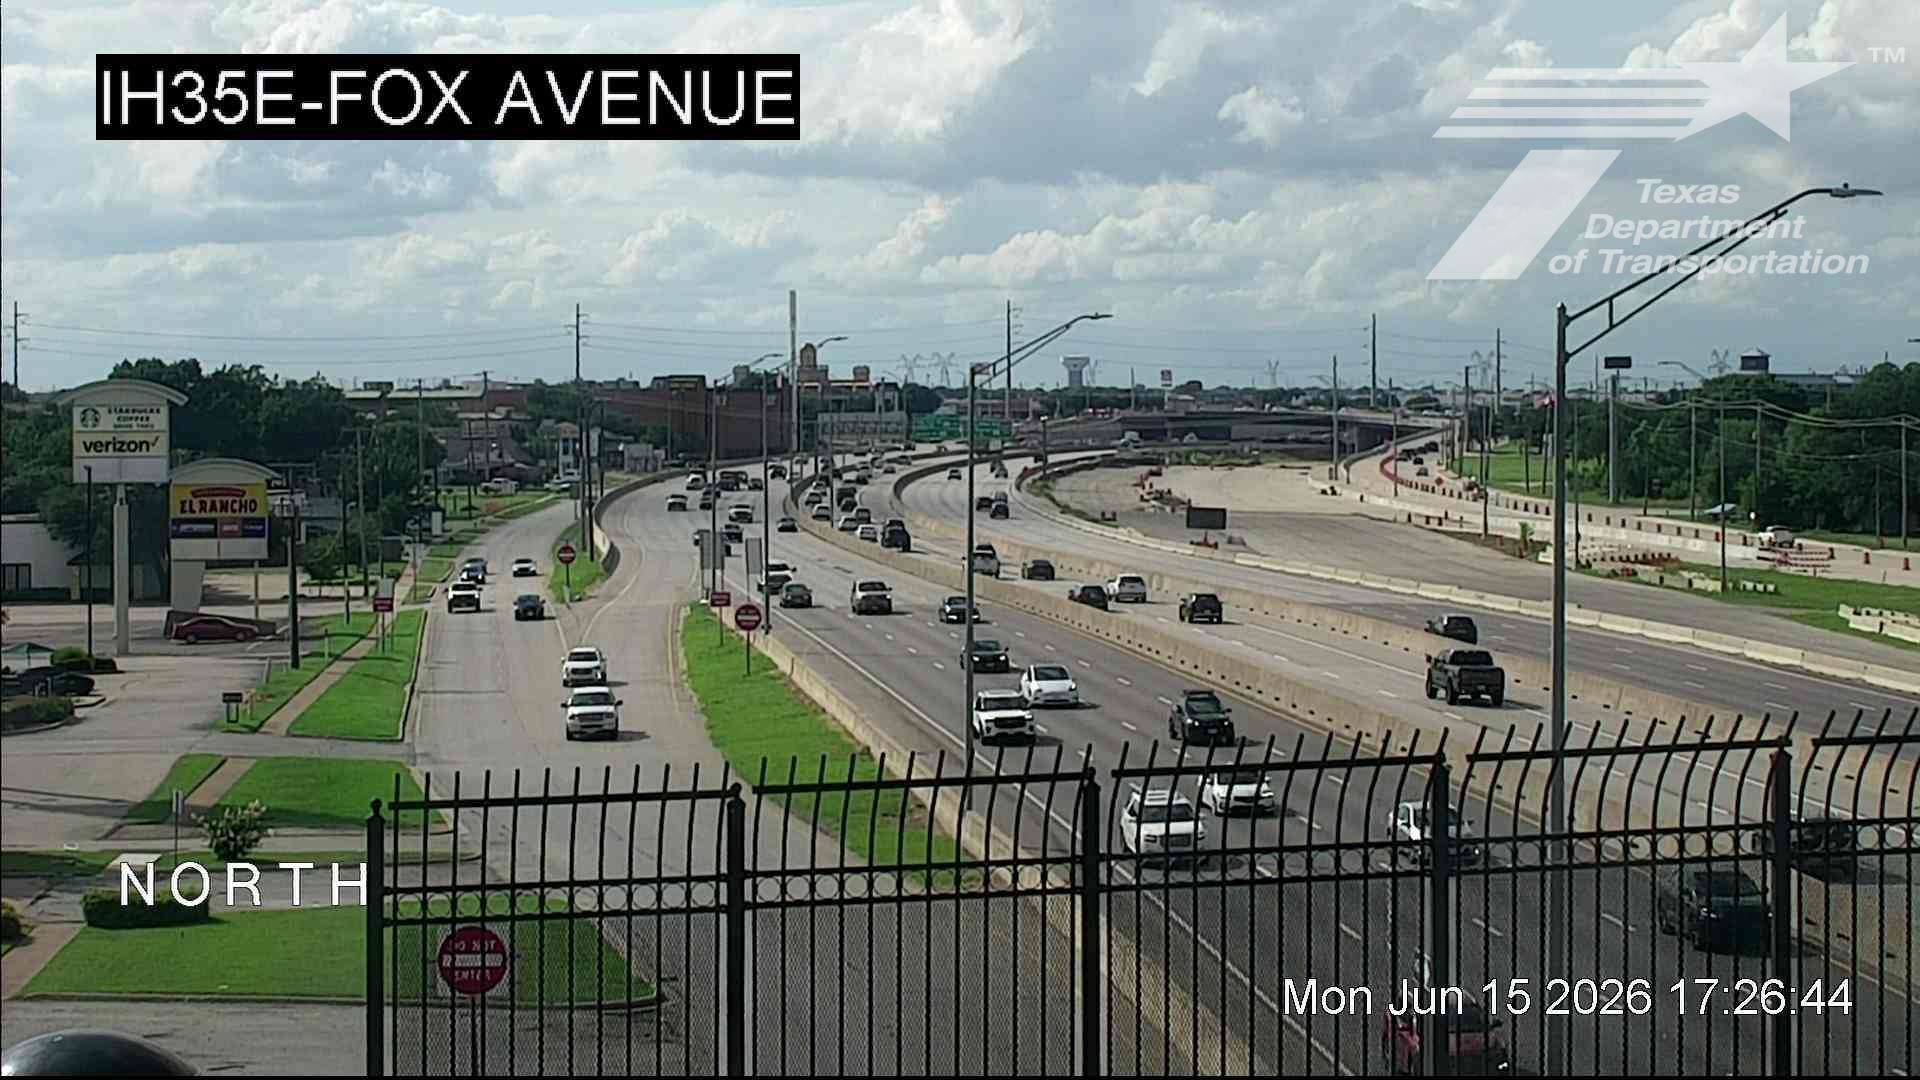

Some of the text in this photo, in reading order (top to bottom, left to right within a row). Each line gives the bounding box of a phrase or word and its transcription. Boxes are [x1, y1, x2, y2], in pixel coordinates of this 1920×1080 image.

[82, 436, 150, 453] verizon
[180, 499, 258, 514] EL RANCHO
